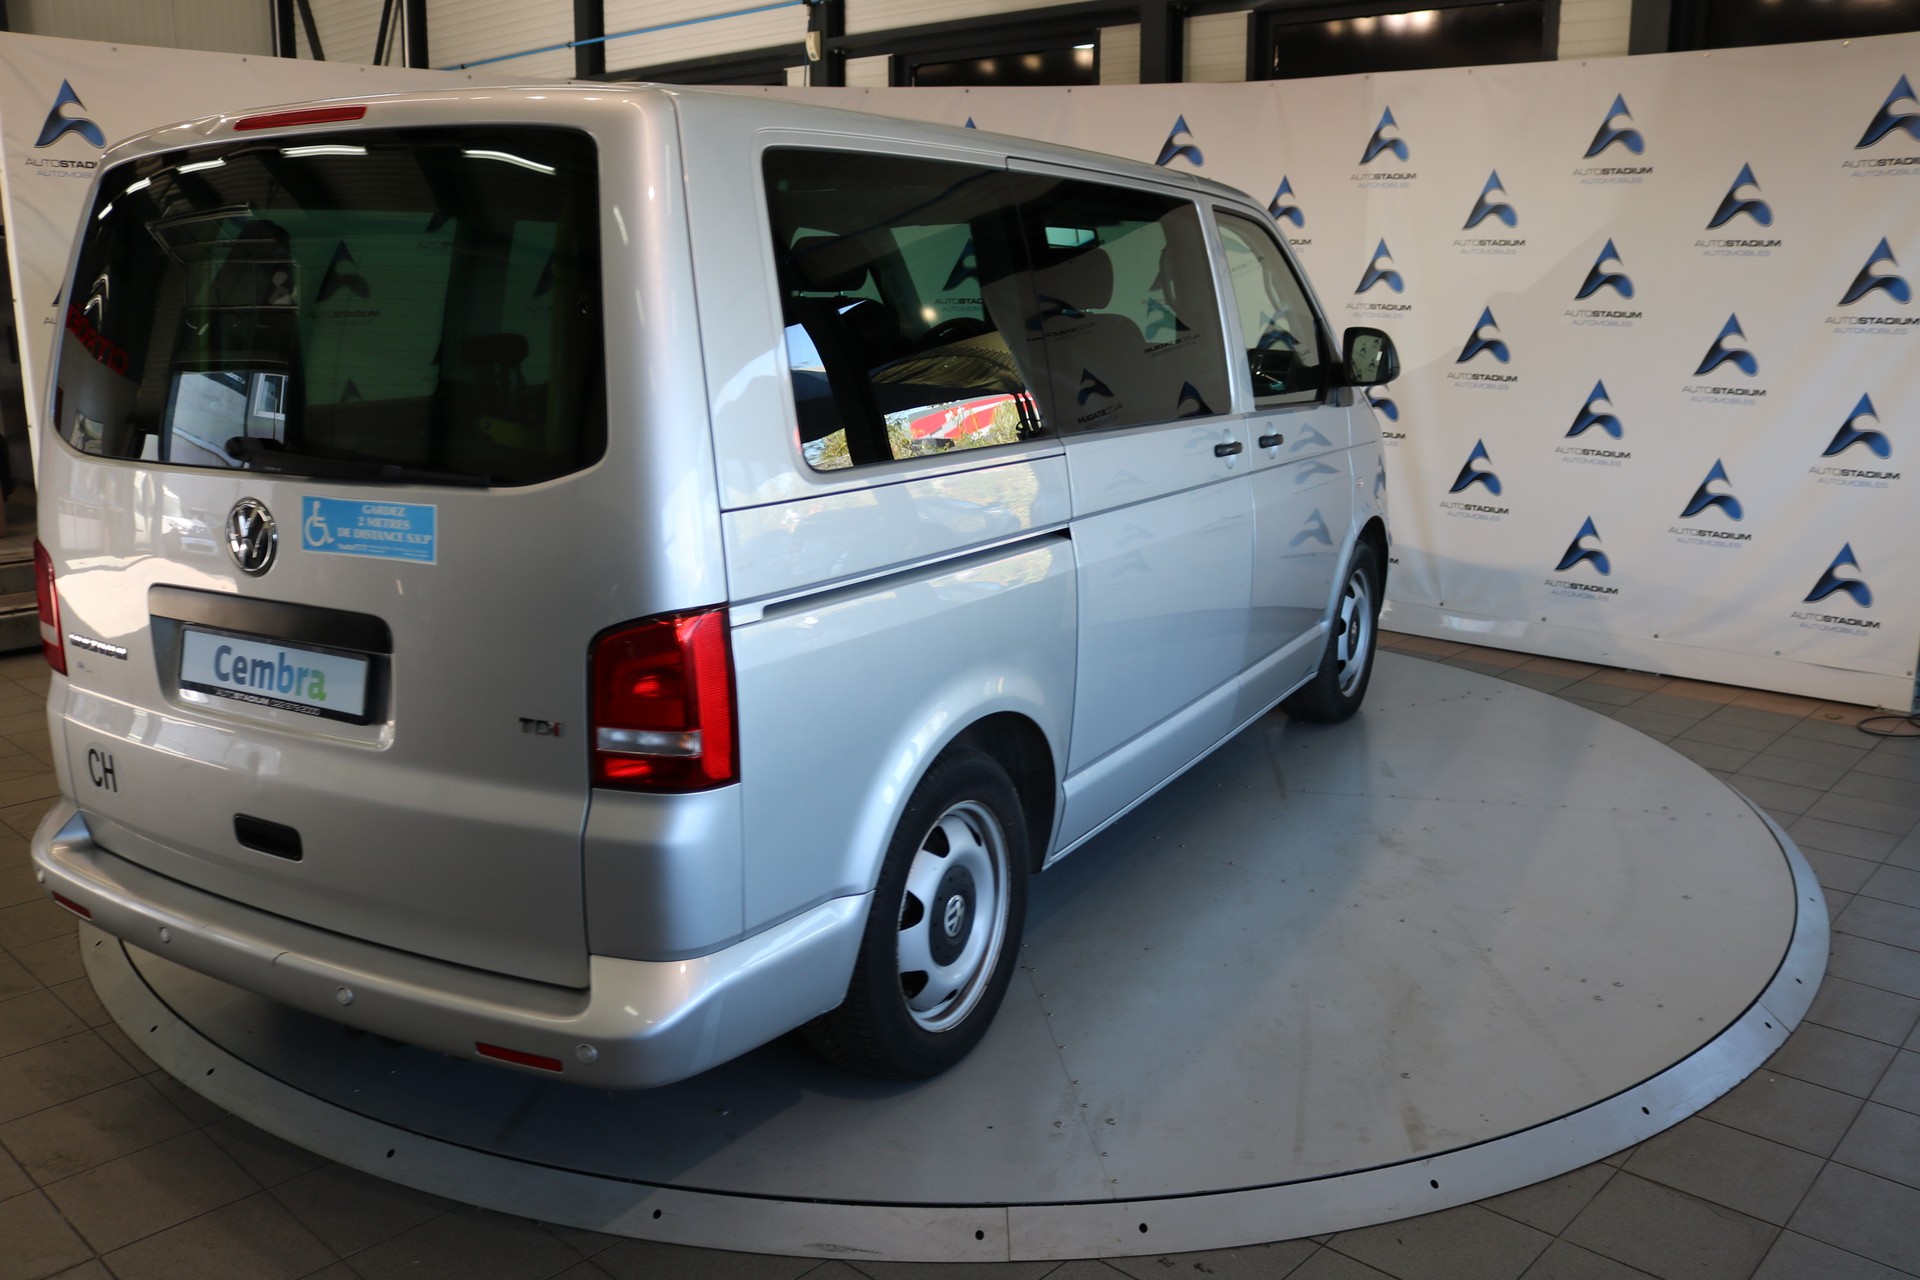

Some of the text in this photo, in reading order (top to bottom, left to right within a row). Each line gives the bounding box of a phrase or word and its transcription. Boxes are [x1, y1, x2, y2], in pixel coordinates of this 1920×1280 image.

[1350, 172, 1417, 181] AUTOSTADIUM
[1573, 166, 1653, 176] AUTOSTADIUM
[1453, 238, 1526, 247] AUTOSTADIUM
[1694, 239, 1782, 248] AUTOSTADIUM
[1346, 302, 1412, 311] AUTOSTADIUM
[1564, 309, 1642, 319] AUTOSTADIUM
[1447, 371, 1517, 382] AUTOSTADIUM
[1682, 384, 1767, 397] AUTOSTADIUM
[1555, 445, 1631, 459] AUTOSTADIUM
[1808, 466, 1901, 480] AUTOSTADIUM
[362, 504, 406, 516] GARDEZ
[1440, 500, 1509, 515] AUTOSTADIUM
[357, 517, 365, 526] 2
[337, 527, 351, 538] DE
[353, 528, 404, 543] DISTANCE
[1668, 525, 1752, 541] AUTOSTADIUM
[1544, 578, 1619, 595] AUTOSTADIUM
[1790, 611, 1881, 629] AUTOSTADIUM
[214, 644, 327, 702] Cembra
[87, 748, 118, 794] CH
